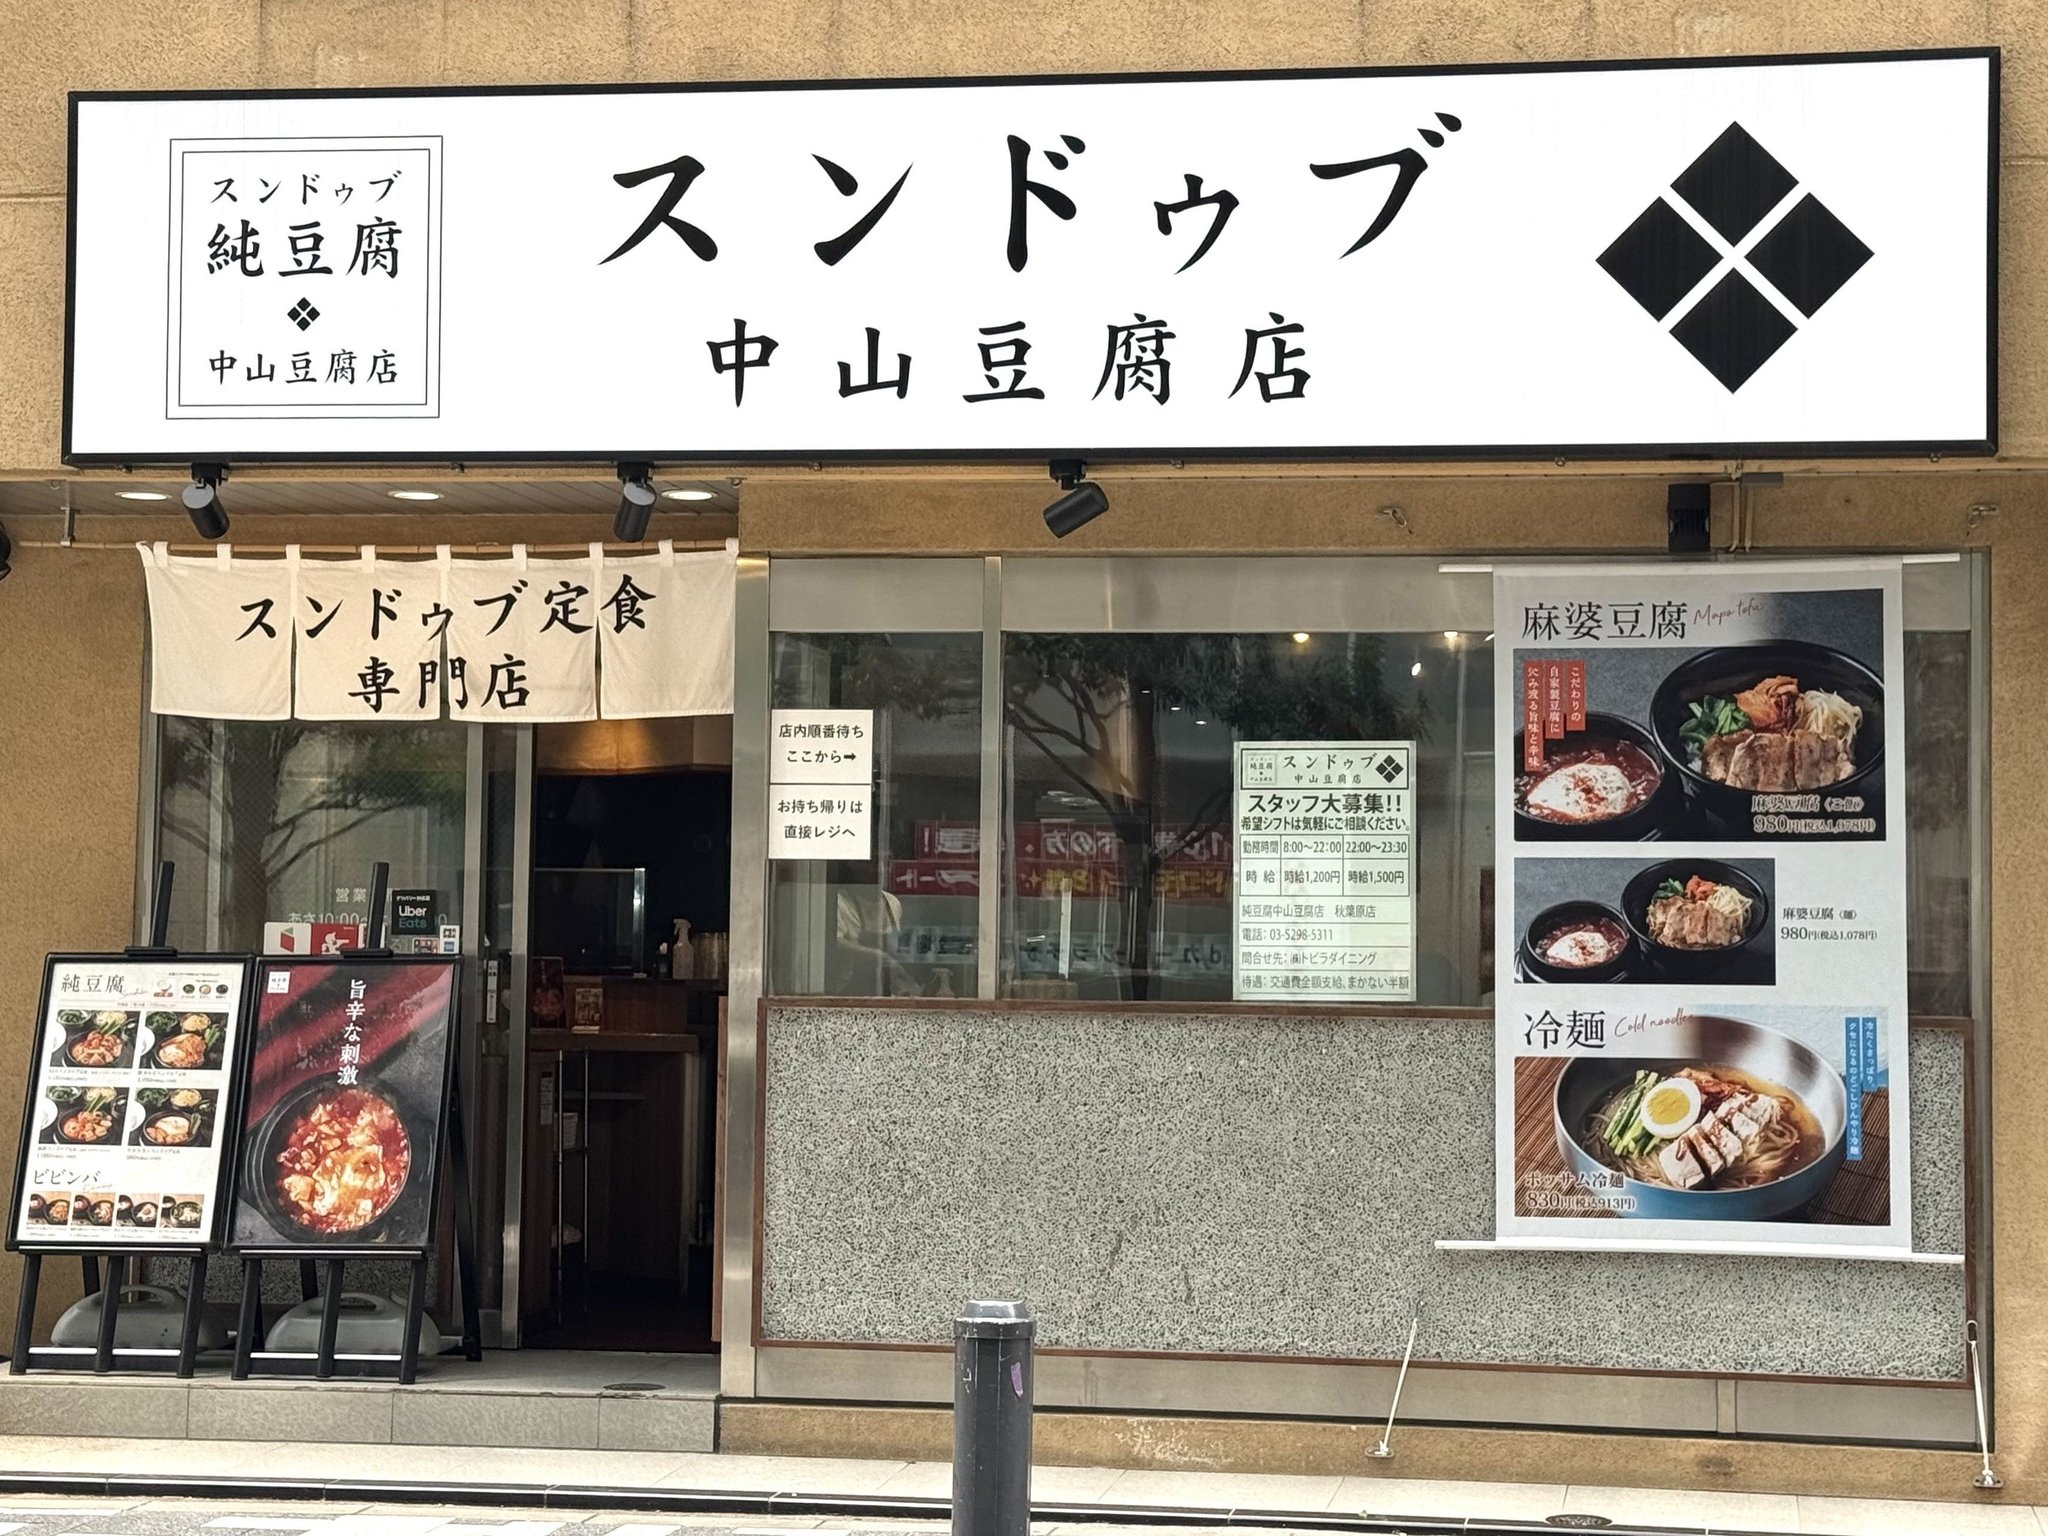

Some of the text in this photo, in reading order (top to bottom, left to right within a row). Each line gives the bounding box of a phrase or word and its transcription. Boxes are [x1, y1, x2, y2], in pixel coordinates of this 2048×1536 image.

[209, 169, 403, 206] スンドゥブ
[598, 111, 1463, 275] スンドゥブ
[207, 215, 403, 279] 純豆腐
[208, 348, 398, 386] 中山豆腐店
[706, 311, 1312, 408] 中山豆腐店
[235, 573, 657, 642] スンドゥブ定食
[1521, 600, 1688, 641] 麻婆豆腐
[348, 653, 531, 713] 専門店
[1570, 666, 1581, 722] こだわりの
[1549, 665, 1560, 734] 自家製豆腐に
[778, 723, 864, 739] 店内順番待ち
[787, 750, 842, 763] ここから
[1283, 752, 1378, 770] スンドゥブ
[1294, 773, 1362, 785] 中山豆腐店
[777, 799, 863, 814] お持ち帰りは
[1247, 793, 1402, 814] スタッフ大募集!!
[783, 824, 856, 839] 直接レジへ
[1241, 816, 1410, 832] 希望シフトは気軽にご相談ください。
[1284, 870, 1341, 884] 時給1,200円
[1348, 870, 1405, 884] 時給1,500円
[398, 905, 427, 917] Uber
[399, 918, 427, 928] Eats
[61, 973, 126, 993] 純豆腐
[336, 979, 367, 1085] 旨辛な刺激
[1524, 1009, 1607, 1050] 冷麺
[1614, 1012, 1647, 1038] Cold
[33, 1168, 102, 1185] ビビンバ
